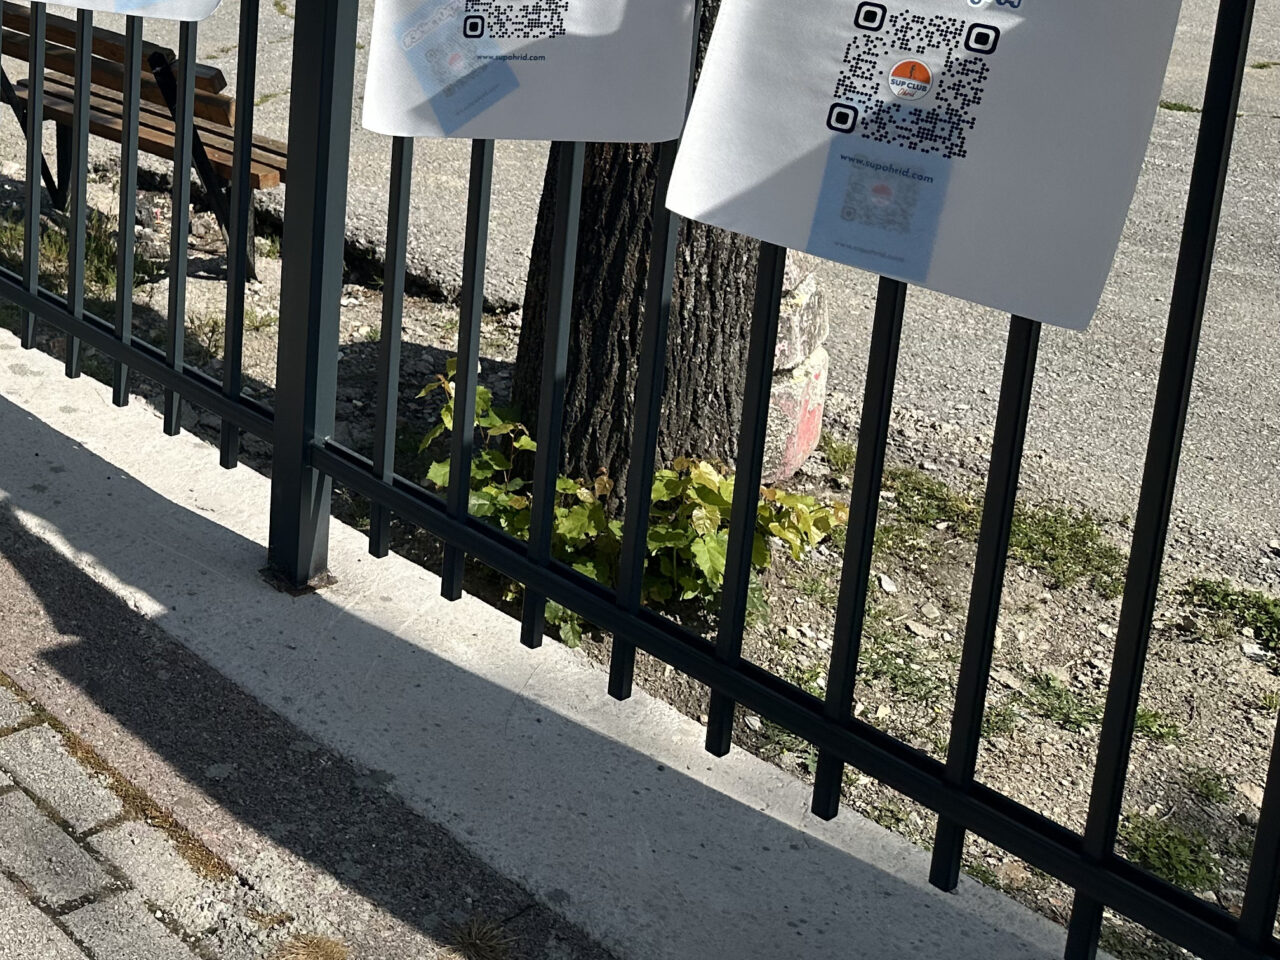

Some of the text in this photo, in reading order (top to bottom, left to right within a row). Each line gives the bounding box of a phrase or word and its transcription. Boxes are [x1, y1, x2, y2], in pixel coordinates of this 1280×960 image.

[890, 78, 928, 92] SUP CLUB
[840, 153, 934, 184] www.supohrid.com
